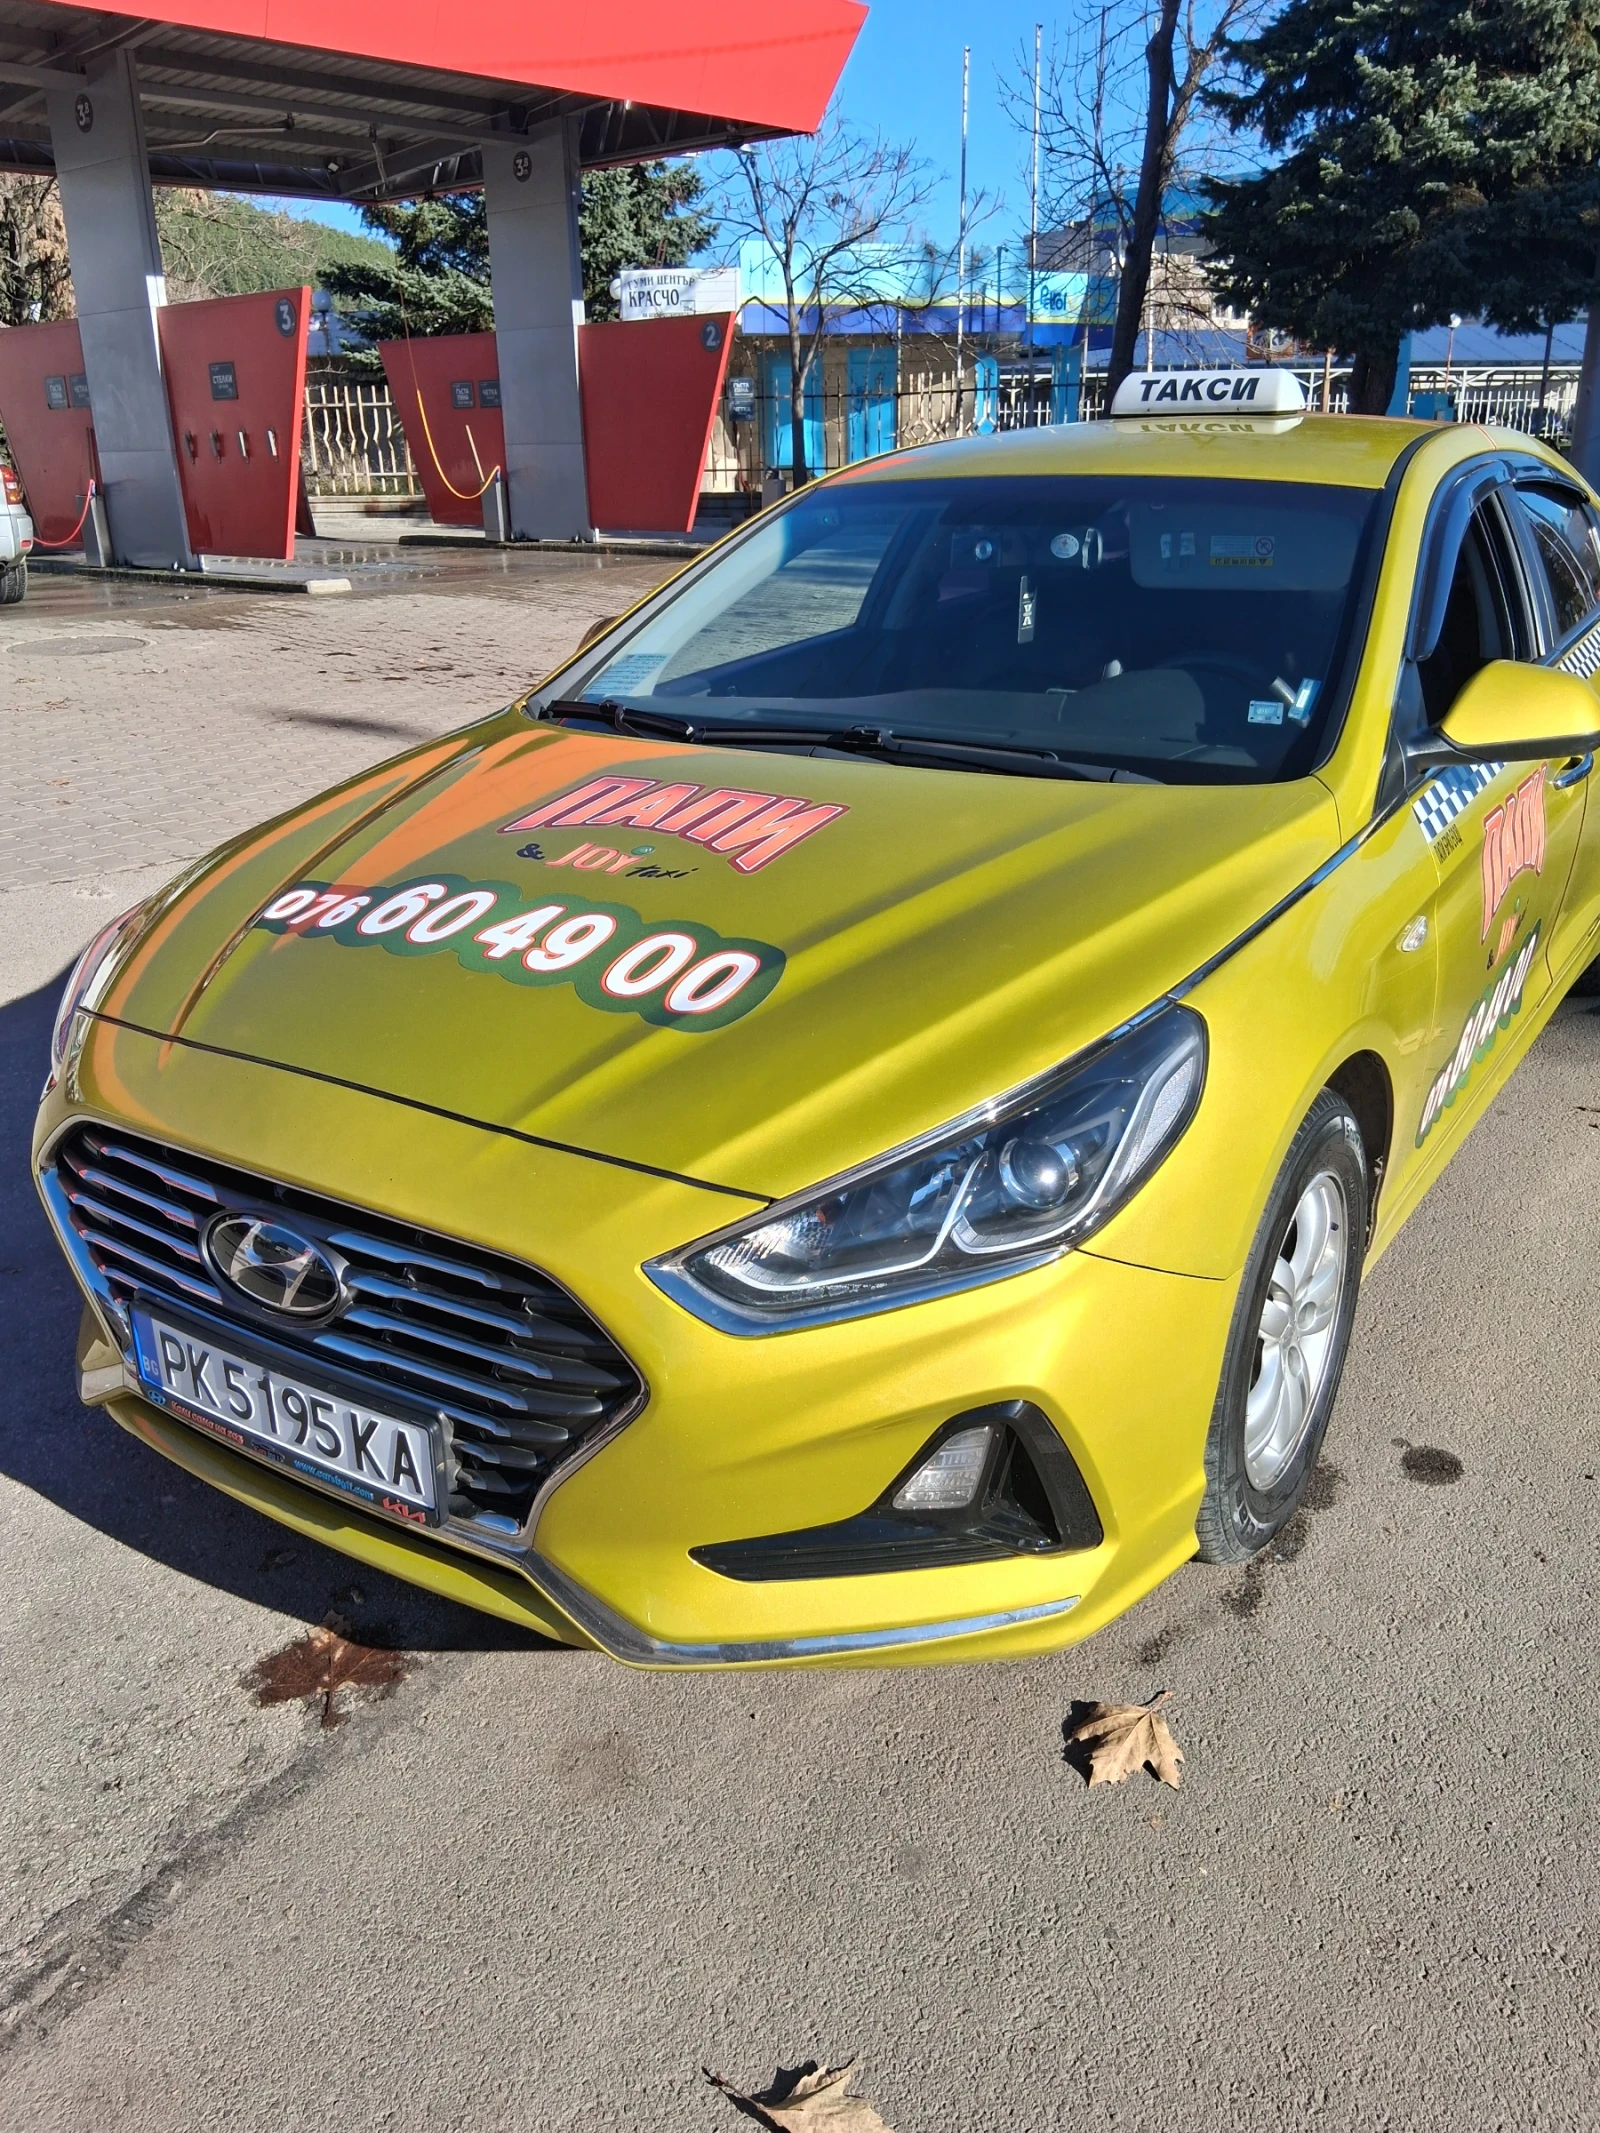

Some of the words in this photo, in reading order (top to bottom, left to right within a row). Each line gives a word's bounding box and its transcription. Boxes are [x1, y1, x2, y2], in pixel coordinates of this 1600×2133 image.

[627, 277, 655, 290] ГУМИ
[656, 274, 696, 287] ЦЕНТЪР
[628, 288, 680, 308] КРАСЧО
[279, 304, 291, 331] 3
[706, 325, 717, 347] 2
[1139, 377, 1261, 402] ТАКСИ
[497, 774, 850, 875] ПАПИ
[516, 842, 546, 861] &
[544, 842, 645, 875] JOY
[625, 864, 700, 879] taxi
[1481, 761, 1548, 946] ПАПИ
[262, 888, 372, 929] 076
[356, 882, 498, 945] 60
[473, 904, 617, 974] 49
[600, 932, 761, 1015] 00
[142, 1355, 159, 1376] BG
[222, 1359, 344, 1460] 5195
